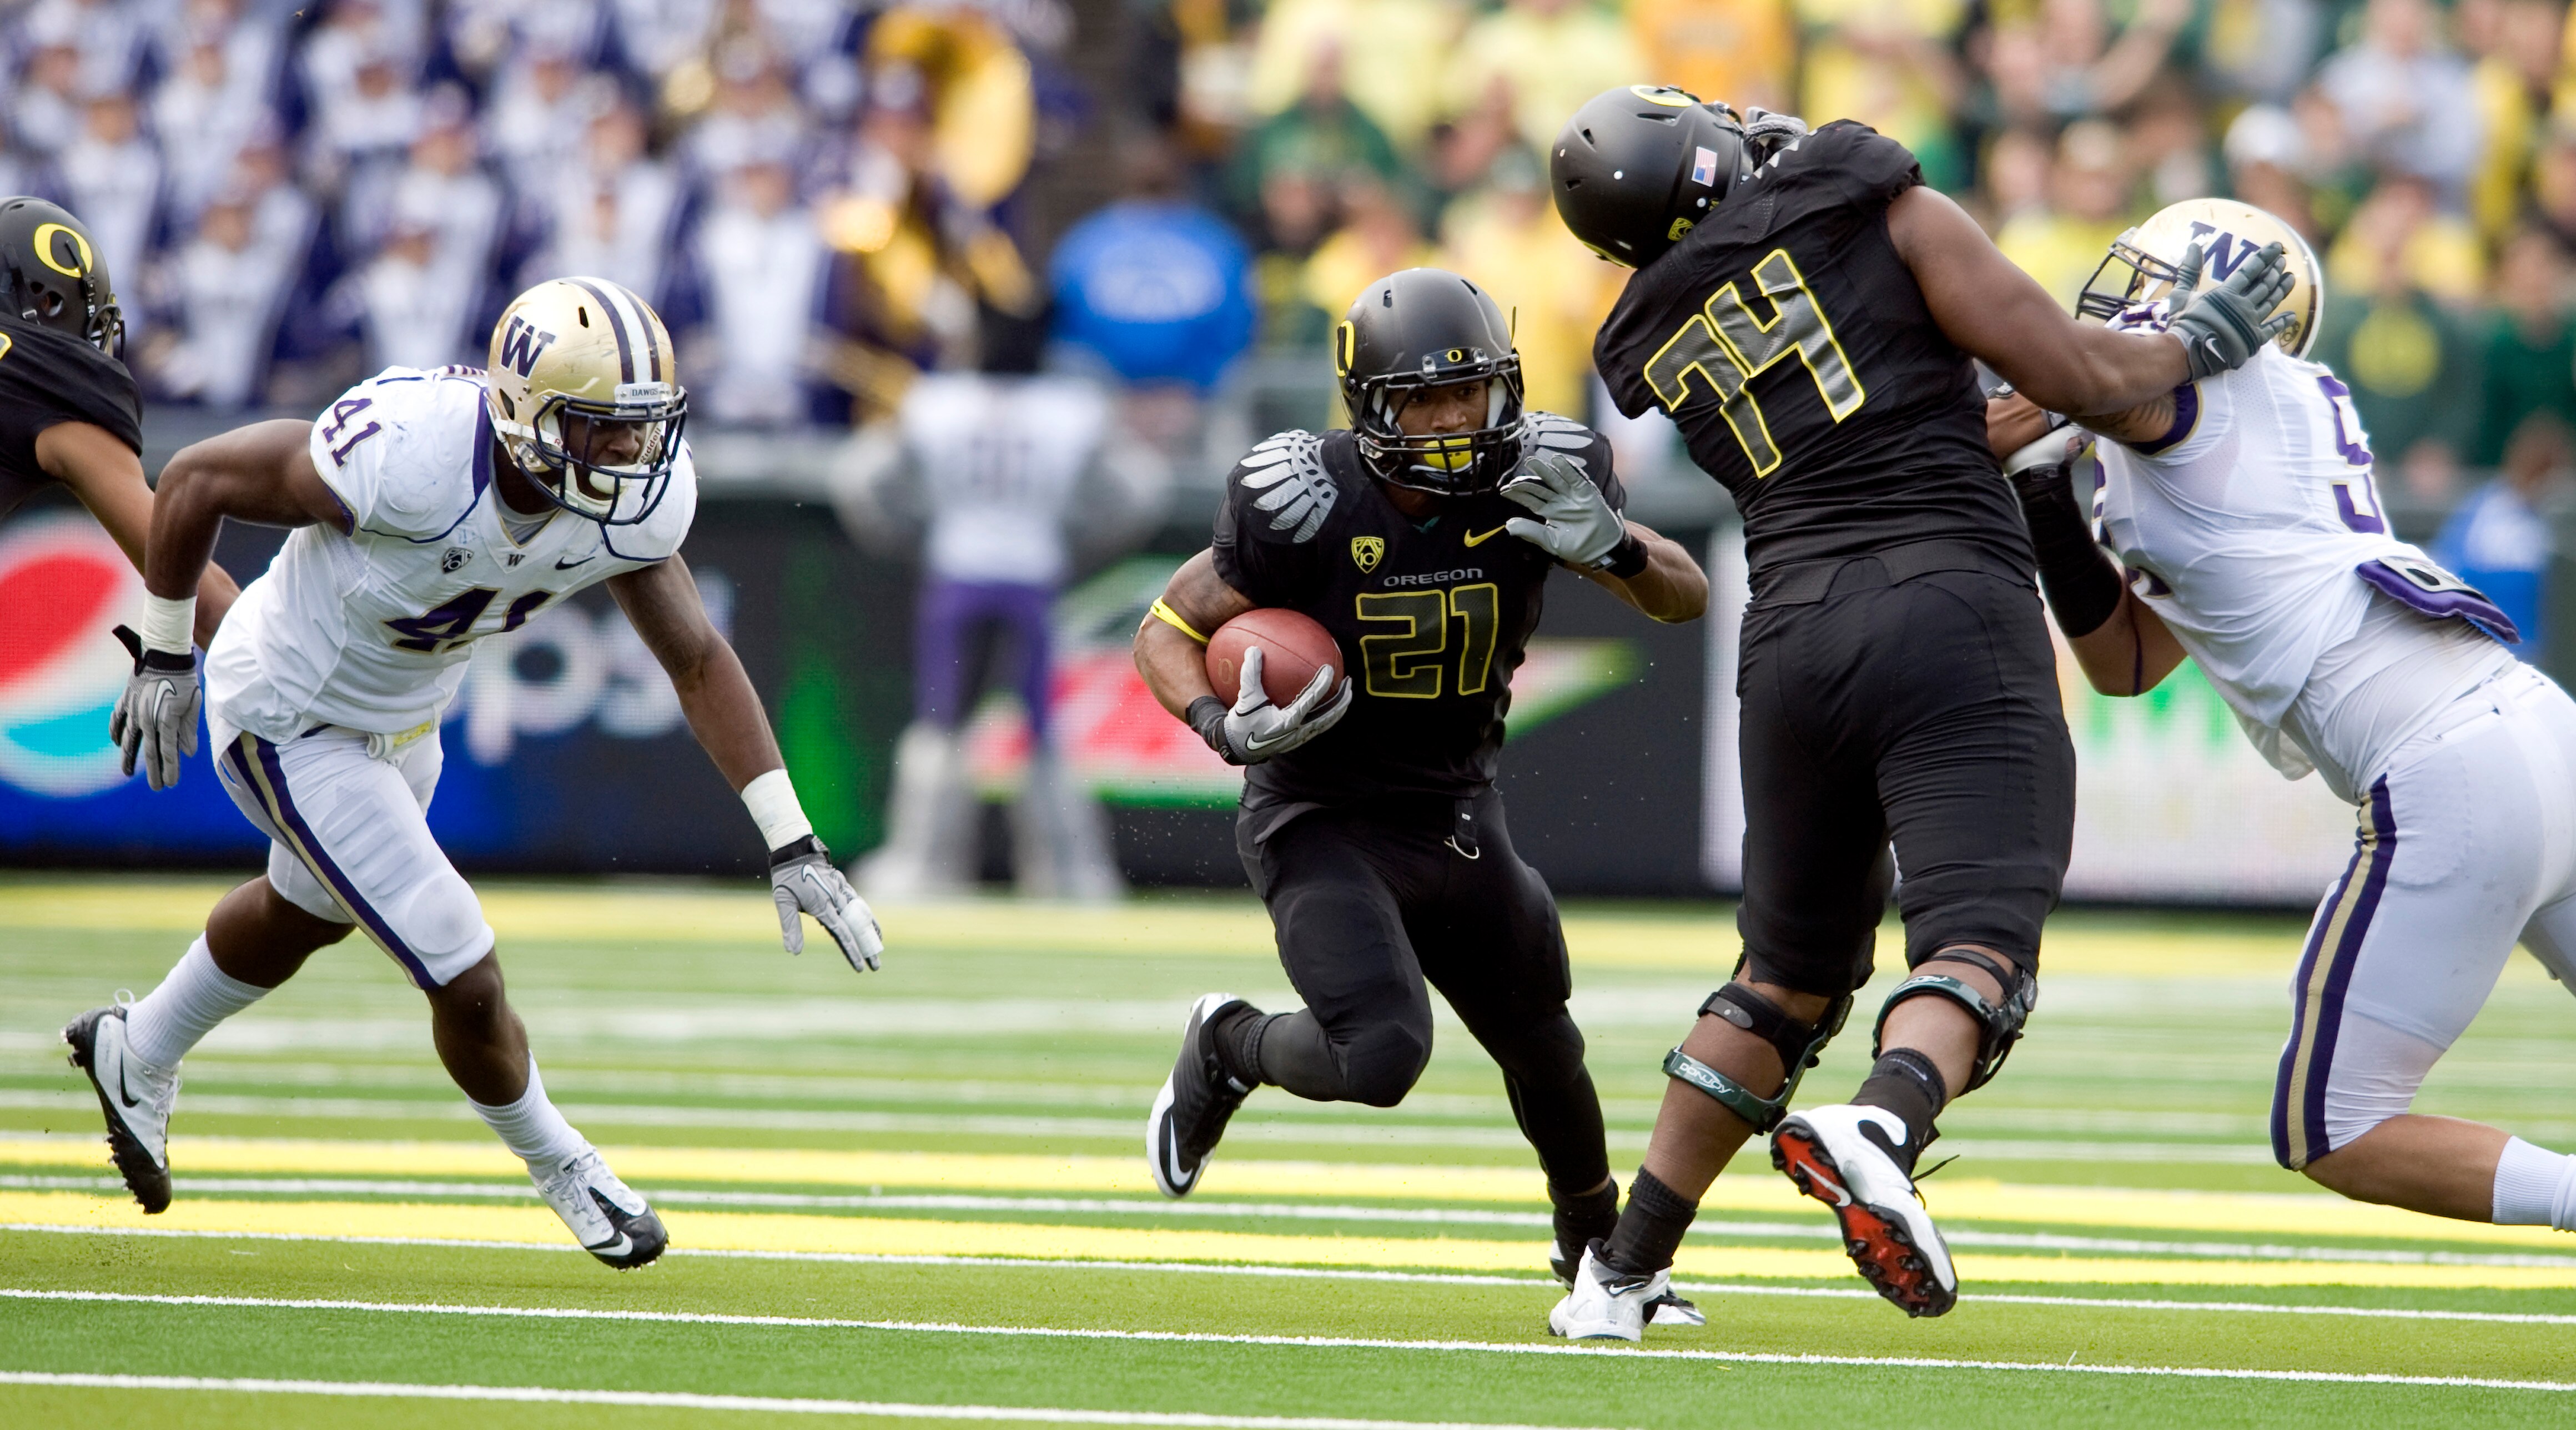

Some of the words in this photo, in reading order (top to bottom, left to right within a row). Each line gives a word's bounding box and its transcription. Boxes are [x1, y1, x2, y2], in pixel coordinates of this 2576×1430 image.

[500, 313, 557, 380] W
[1447, 349, 1462, 362] O
[1643, 248, 1865, 479] 74
[321, 397, 383, 471] 41
[640, 426, 662, 464] Riddell
[507, 553, 526, 567] W
[1354, 538, 1382, 557] PAC
[1360, 552, 1376, 566] 10
[1383, 567, 1483, 587] OREGON
[1355, 582, 1499, 699] 21
[1679, 1061, 1733, 1094] DONJOY
